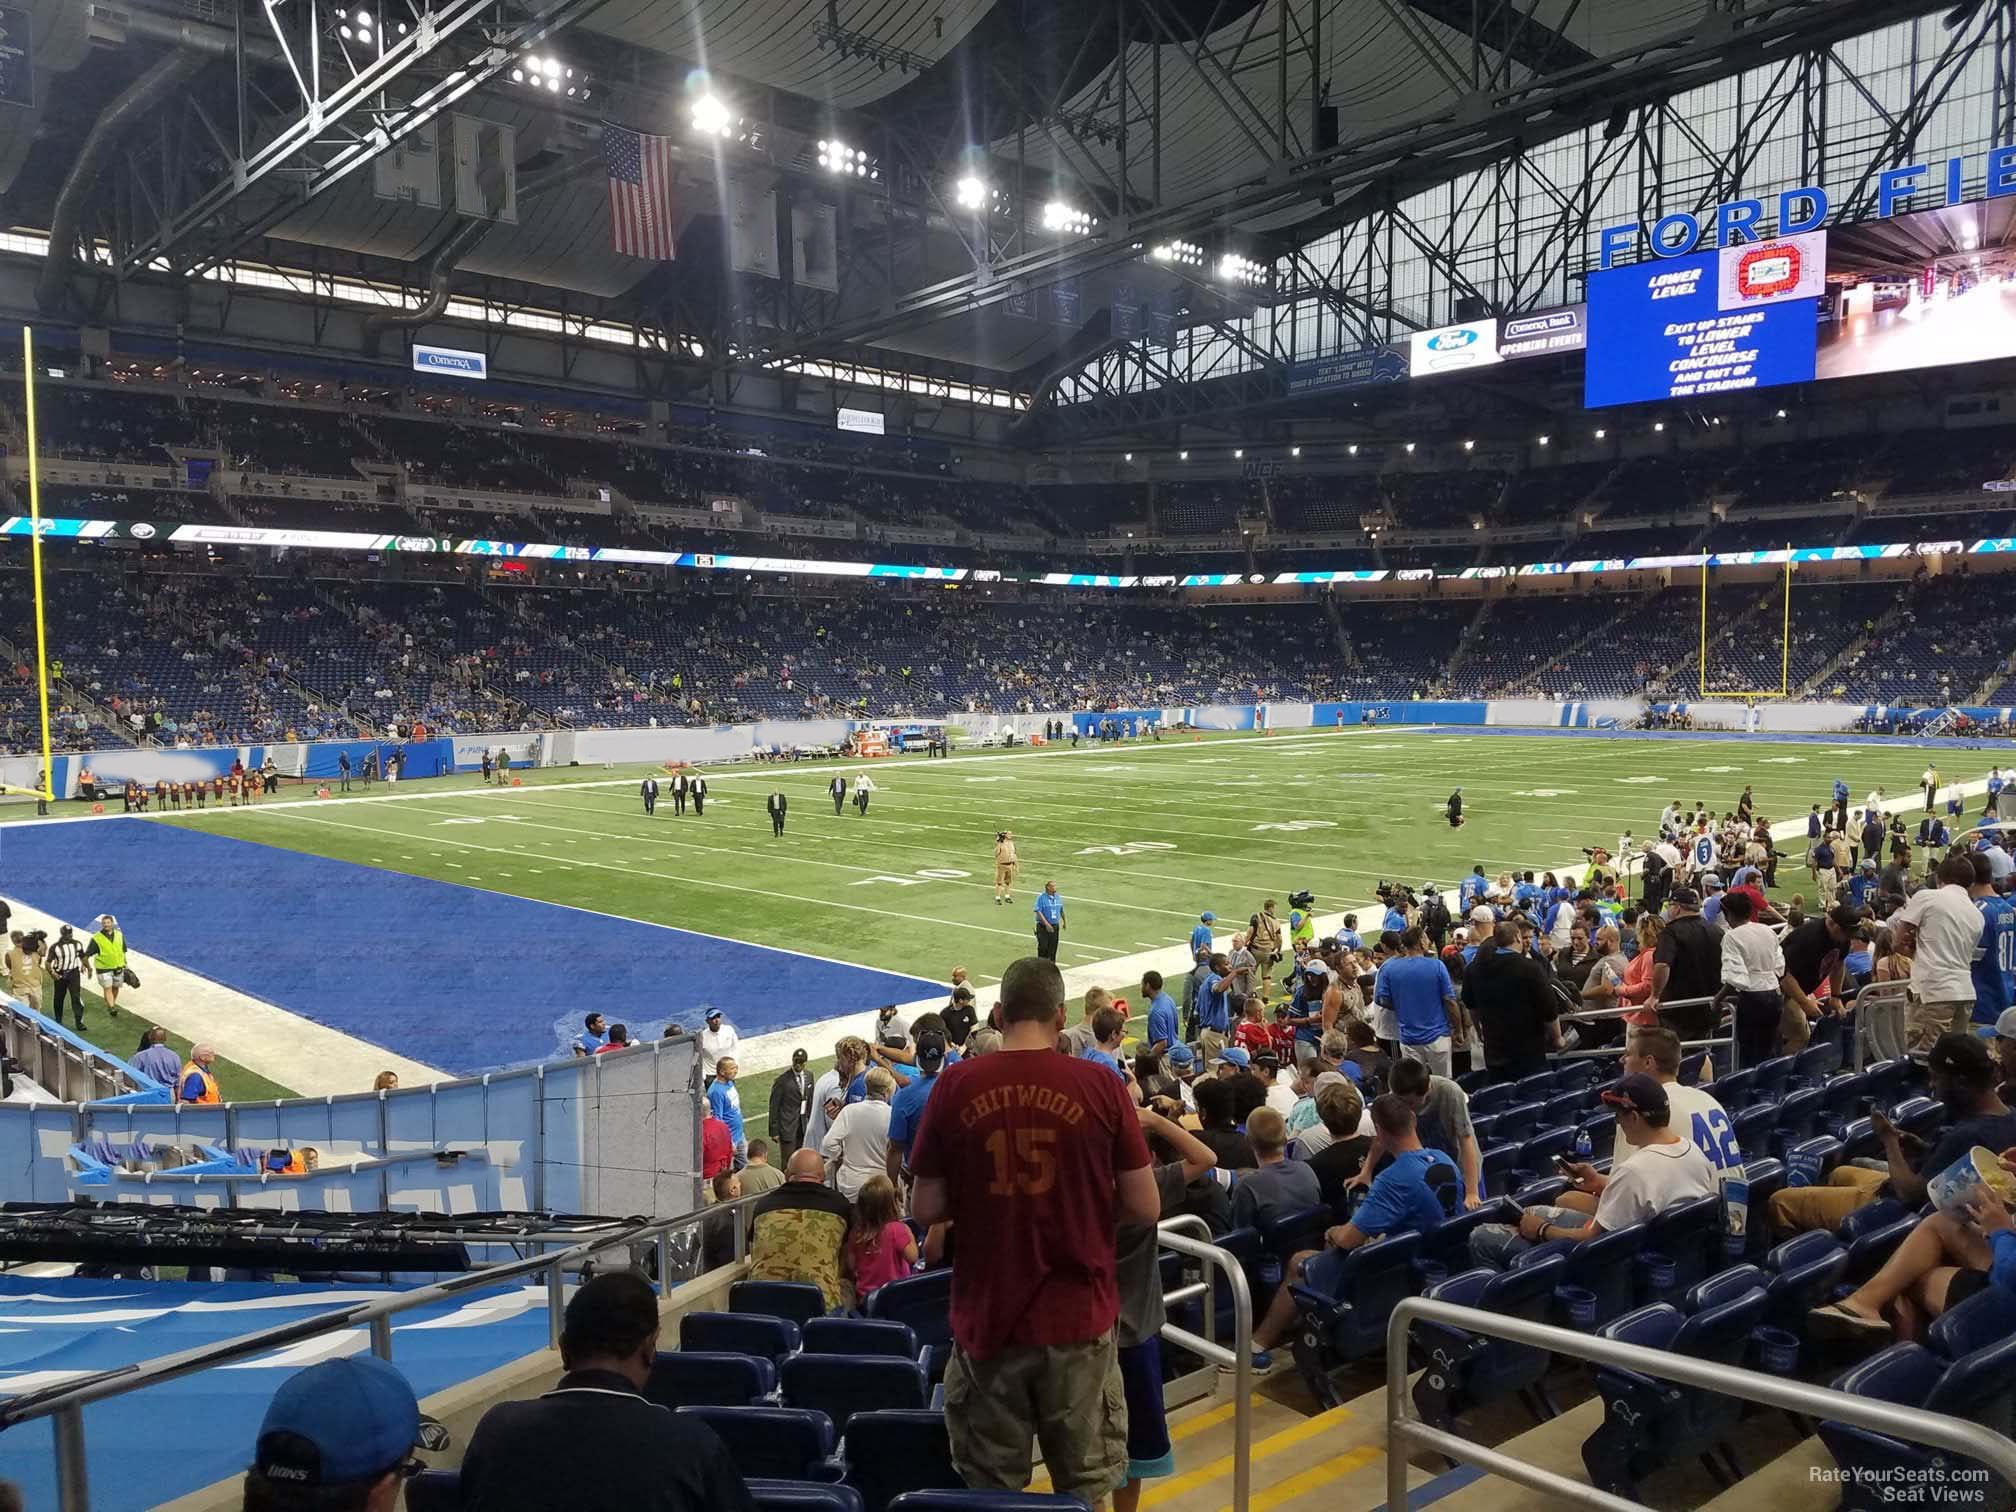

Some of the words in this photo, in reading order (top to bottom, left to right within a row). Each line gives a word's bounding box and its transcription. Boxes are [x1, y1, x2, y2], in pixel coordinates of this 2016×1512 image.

[1599, 185, 1830, 271] FORD
[1648, 268, 1703, 289] LOWER
[1651, 282, 1697, 300] LEVEL
[1697, 319, 1716, 332] UP
[1716, 312, 1765, 329] STAIRS
[1500, 338, 1549, 355] UPCOMING
[1549, 333, 1583, 348] EVENTS
[1677, 335, 1695, 346] TO
[1695, 325, 1753, 344] LOWER
[1690, 340, 1736, 357] LEVEL
[1668, 349, 1760, 373] CONCOURSE
[1674, 371, 1703, 384] AND
[1703, 367, 1732, 380] OUT
[1733, 364, 1753, 376] OF
[1670, 384, 1695, 397] THE
[1696, 376, 1758, 394] STADIUM
[1701, 847, 1708, 862] 3
[959, 1084, 1085, 1128] CHITWOOD
[1691, 1108, 1744, 1171] 42
[984, 1127, 1057, 1197] 15
[267, 1464, 310, 1481] LIONS
